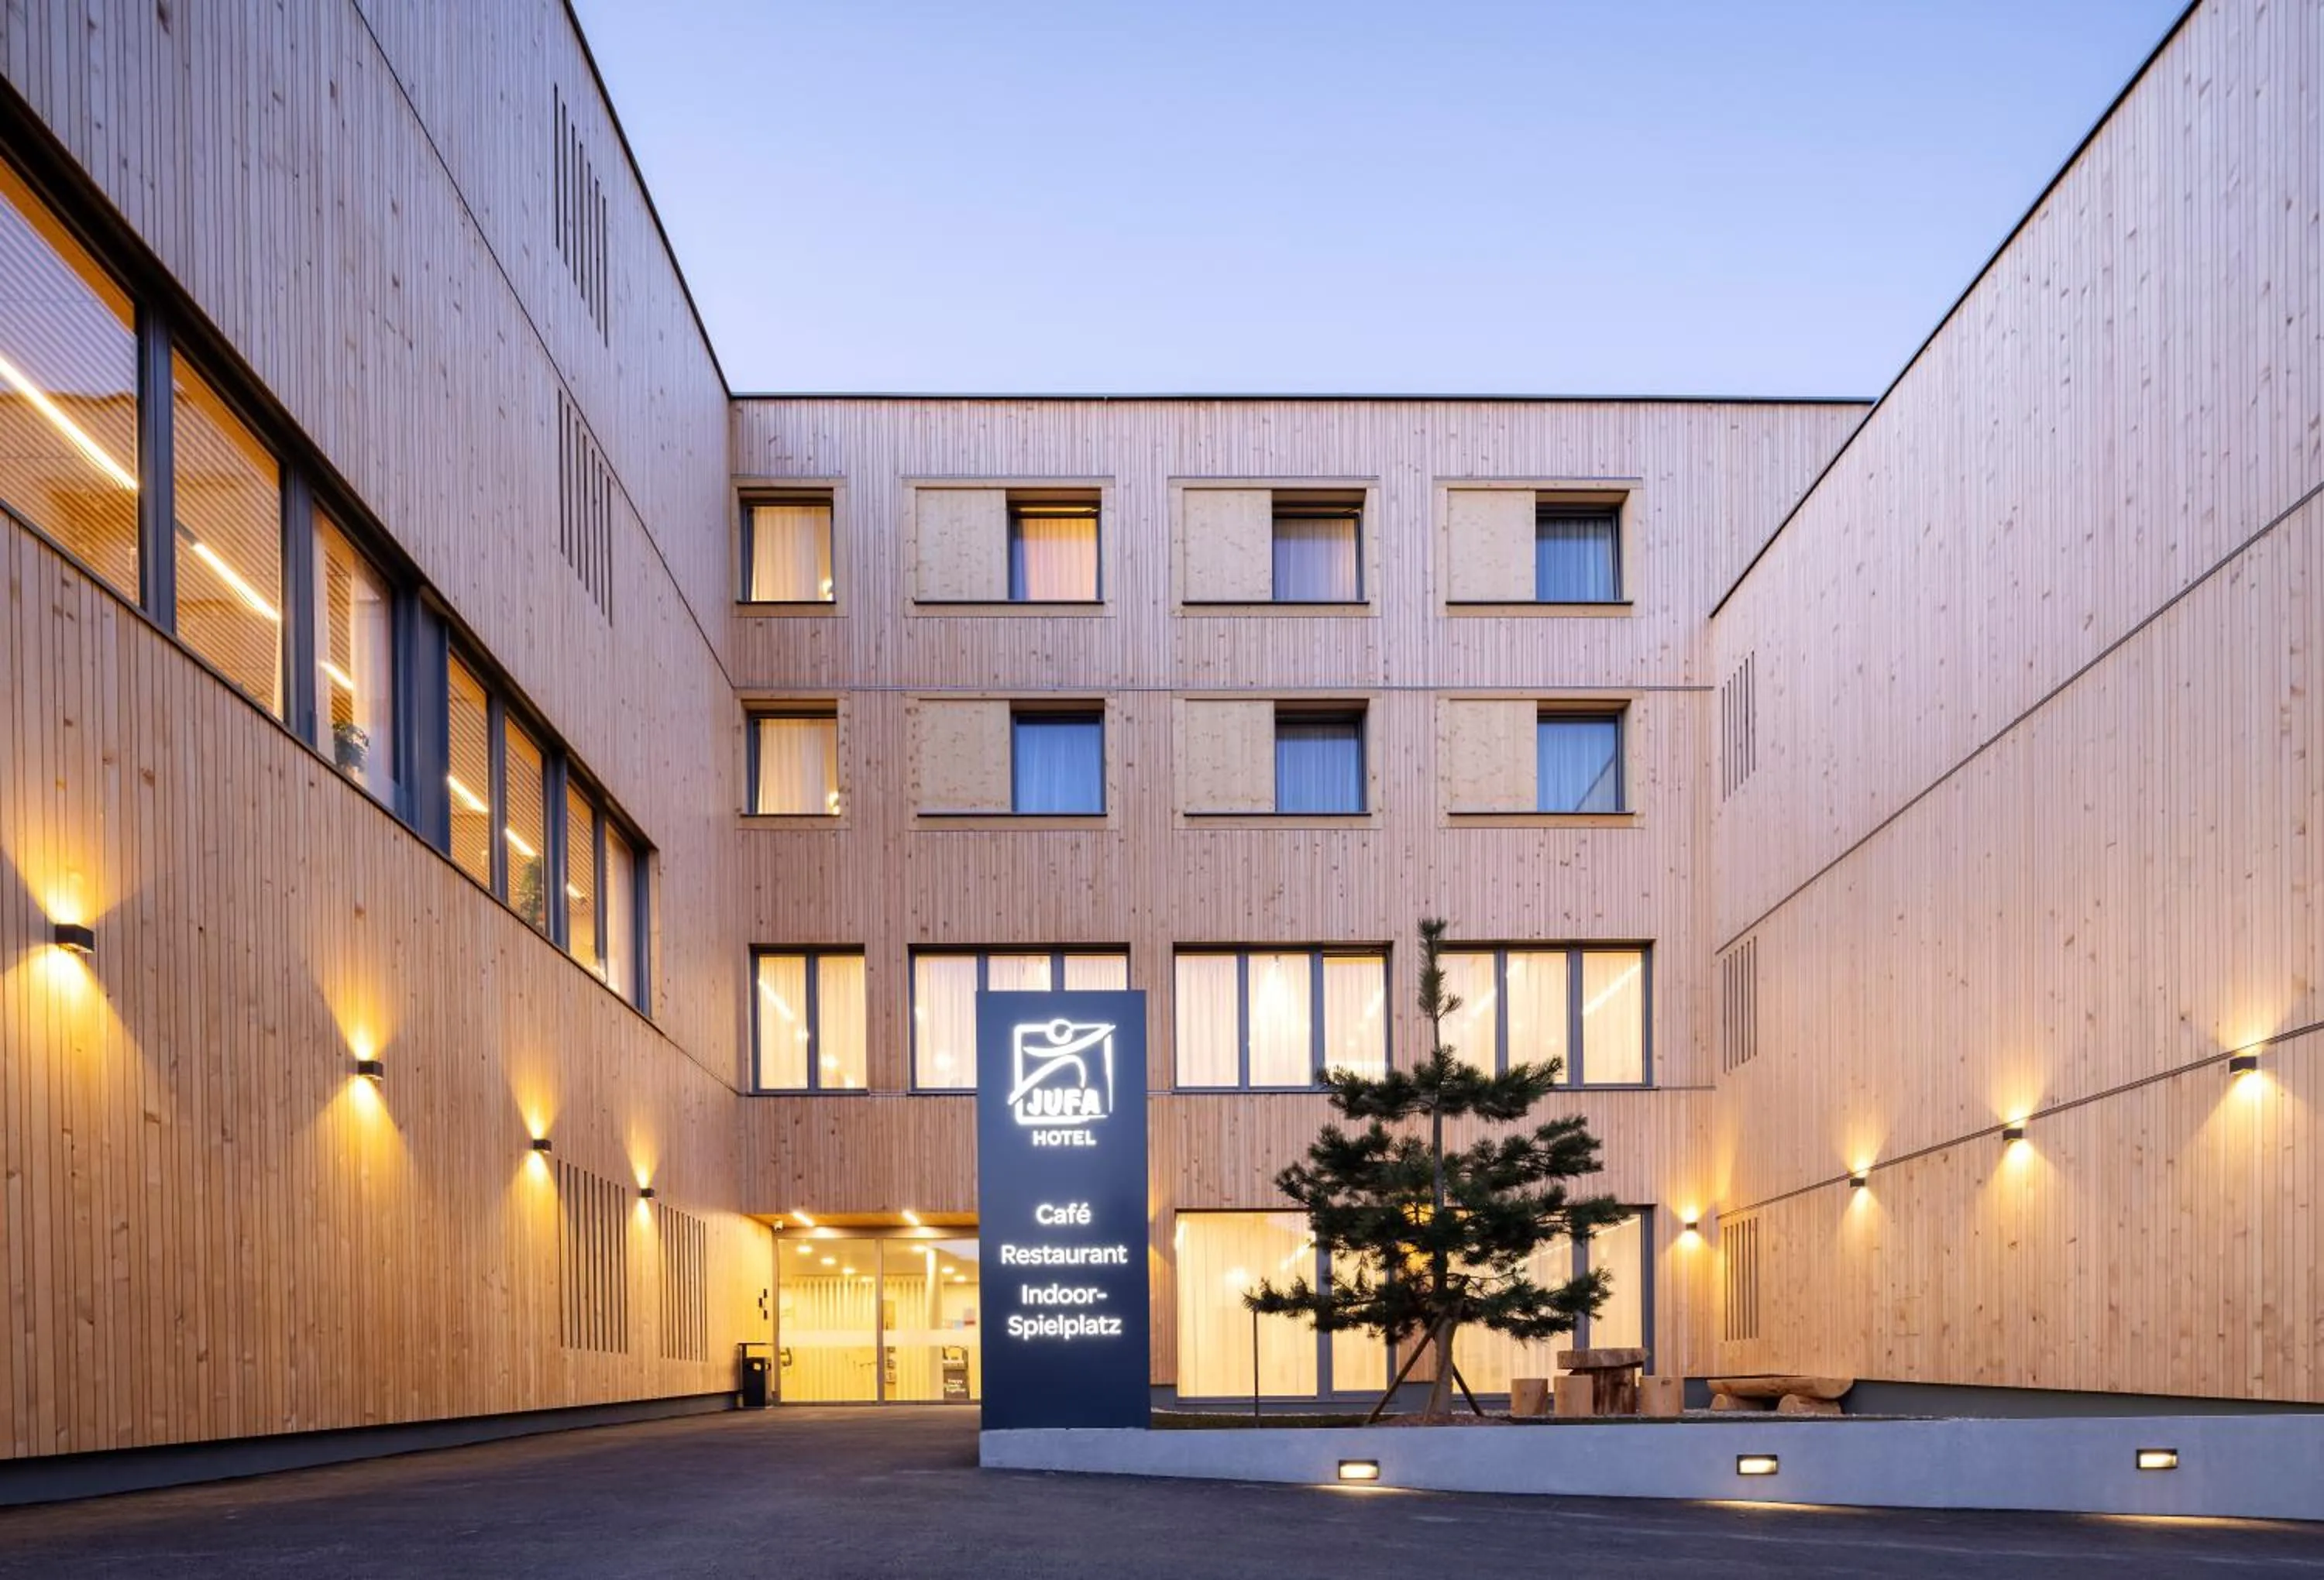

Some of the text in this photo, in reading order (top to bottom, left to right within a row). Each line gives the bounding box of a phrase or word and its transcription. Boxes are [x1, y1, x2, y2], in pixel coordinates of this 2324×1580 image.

[1026, 1087, 1101, 1116] JUFA
[1032, 1129, 1097, 1146] HOTEL
[1035, 1201, 1092, 1225] Café
[1000, 1243, 1128, 1266] Restaurant
[1021, 1283, 1108, 1305] Indoor-
[1008, 1314, 1122, 1341] Spielplatz
